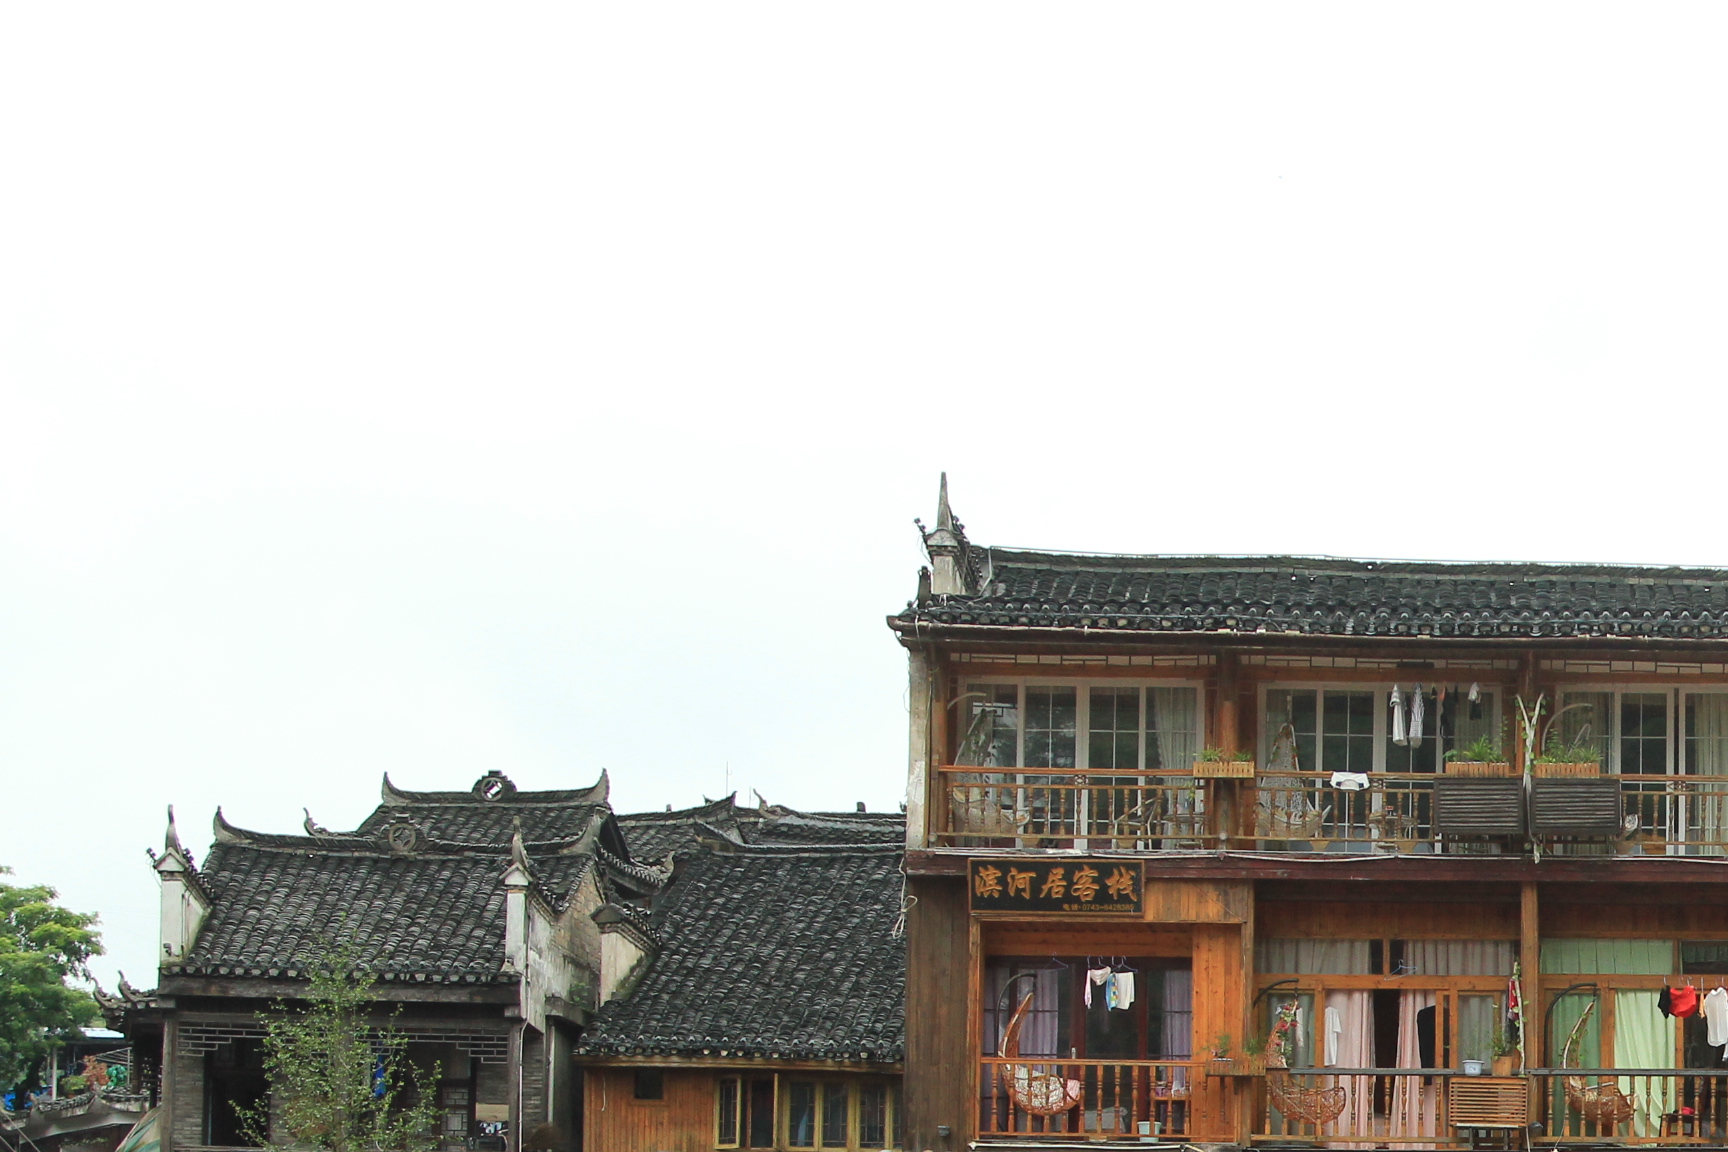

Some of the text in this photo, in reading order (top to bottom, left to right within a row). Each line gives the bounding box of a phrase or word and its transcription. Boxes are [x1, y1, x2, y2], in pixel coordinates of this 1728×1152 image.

[974, 864, 1138, 902] 滨河居客栈
